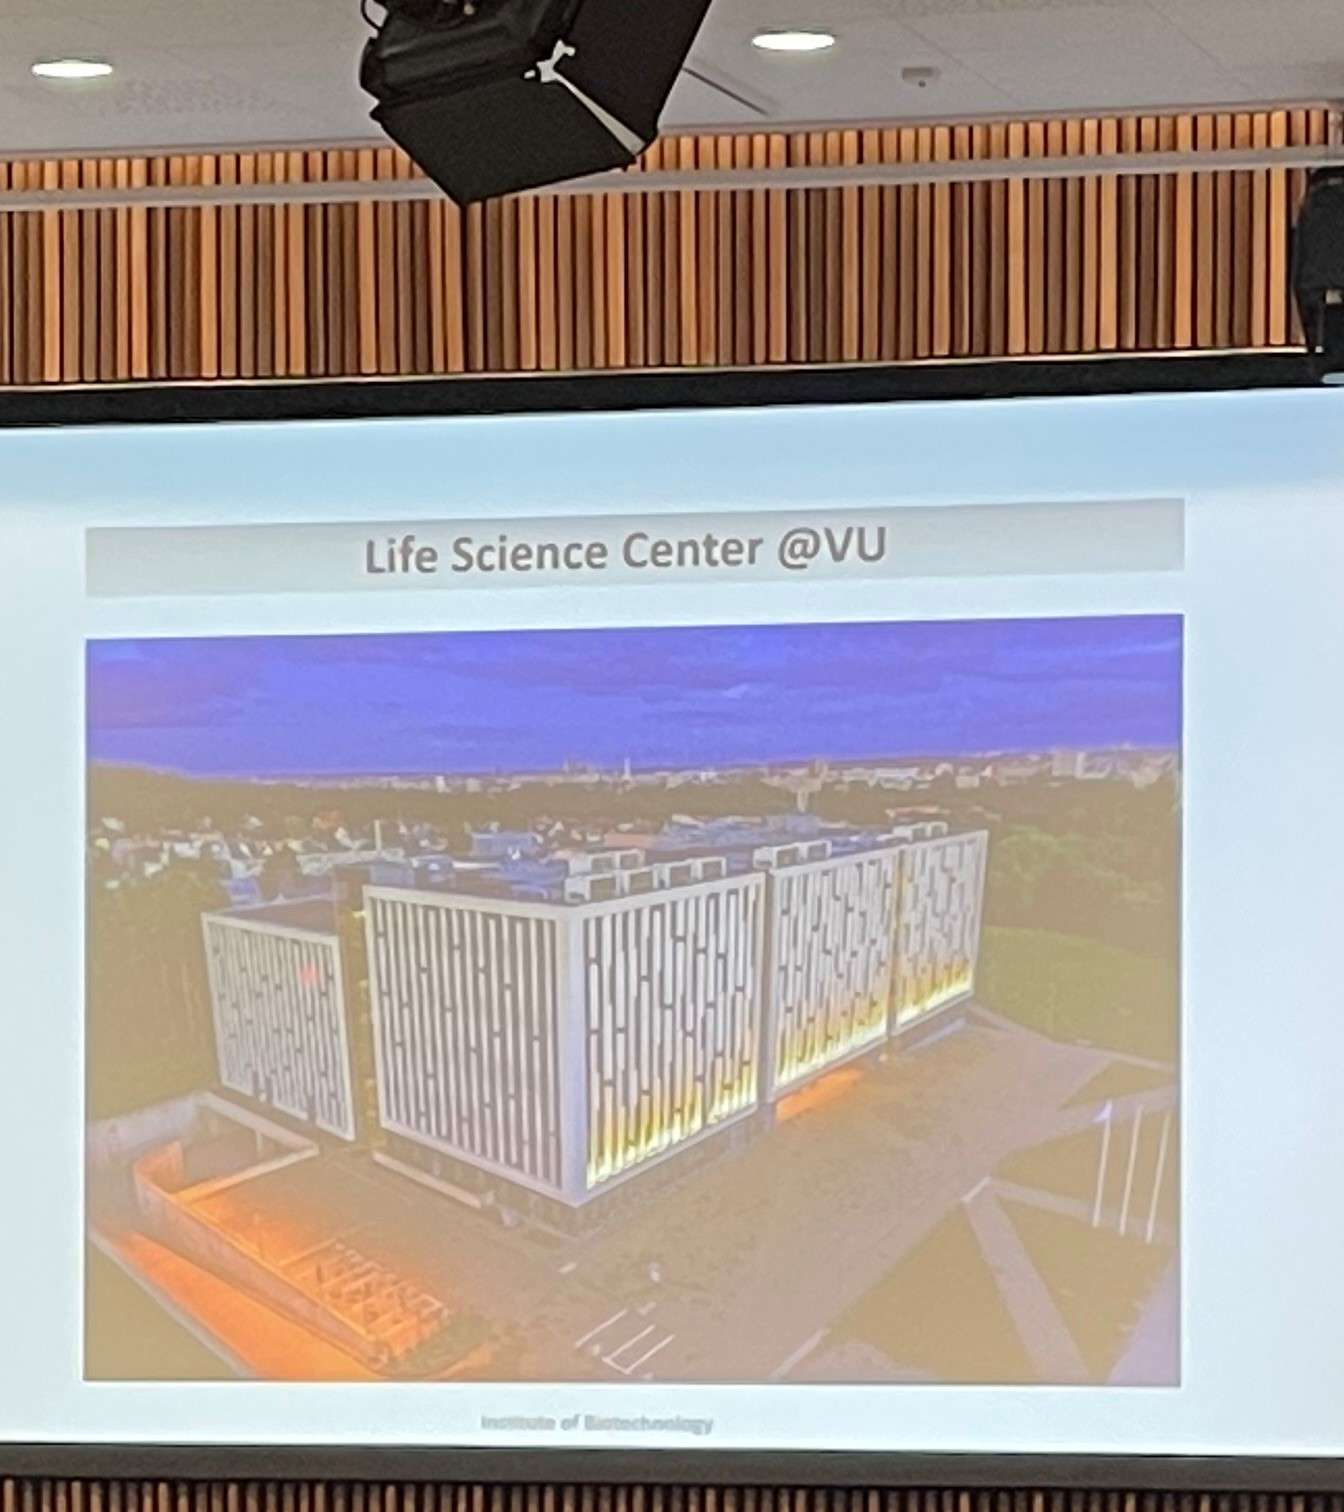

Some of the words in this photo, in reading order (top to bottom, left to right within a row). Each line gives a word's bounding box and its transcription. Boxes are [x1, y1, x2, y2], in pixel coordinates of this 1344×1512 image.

[365, 533, 439, 575] Life
[450, 532, 609, 574] Science
[622, 531, 765, 571] Center
[777, 525, 887, 571] @VU
[560, 1413, 582, 1431] of
